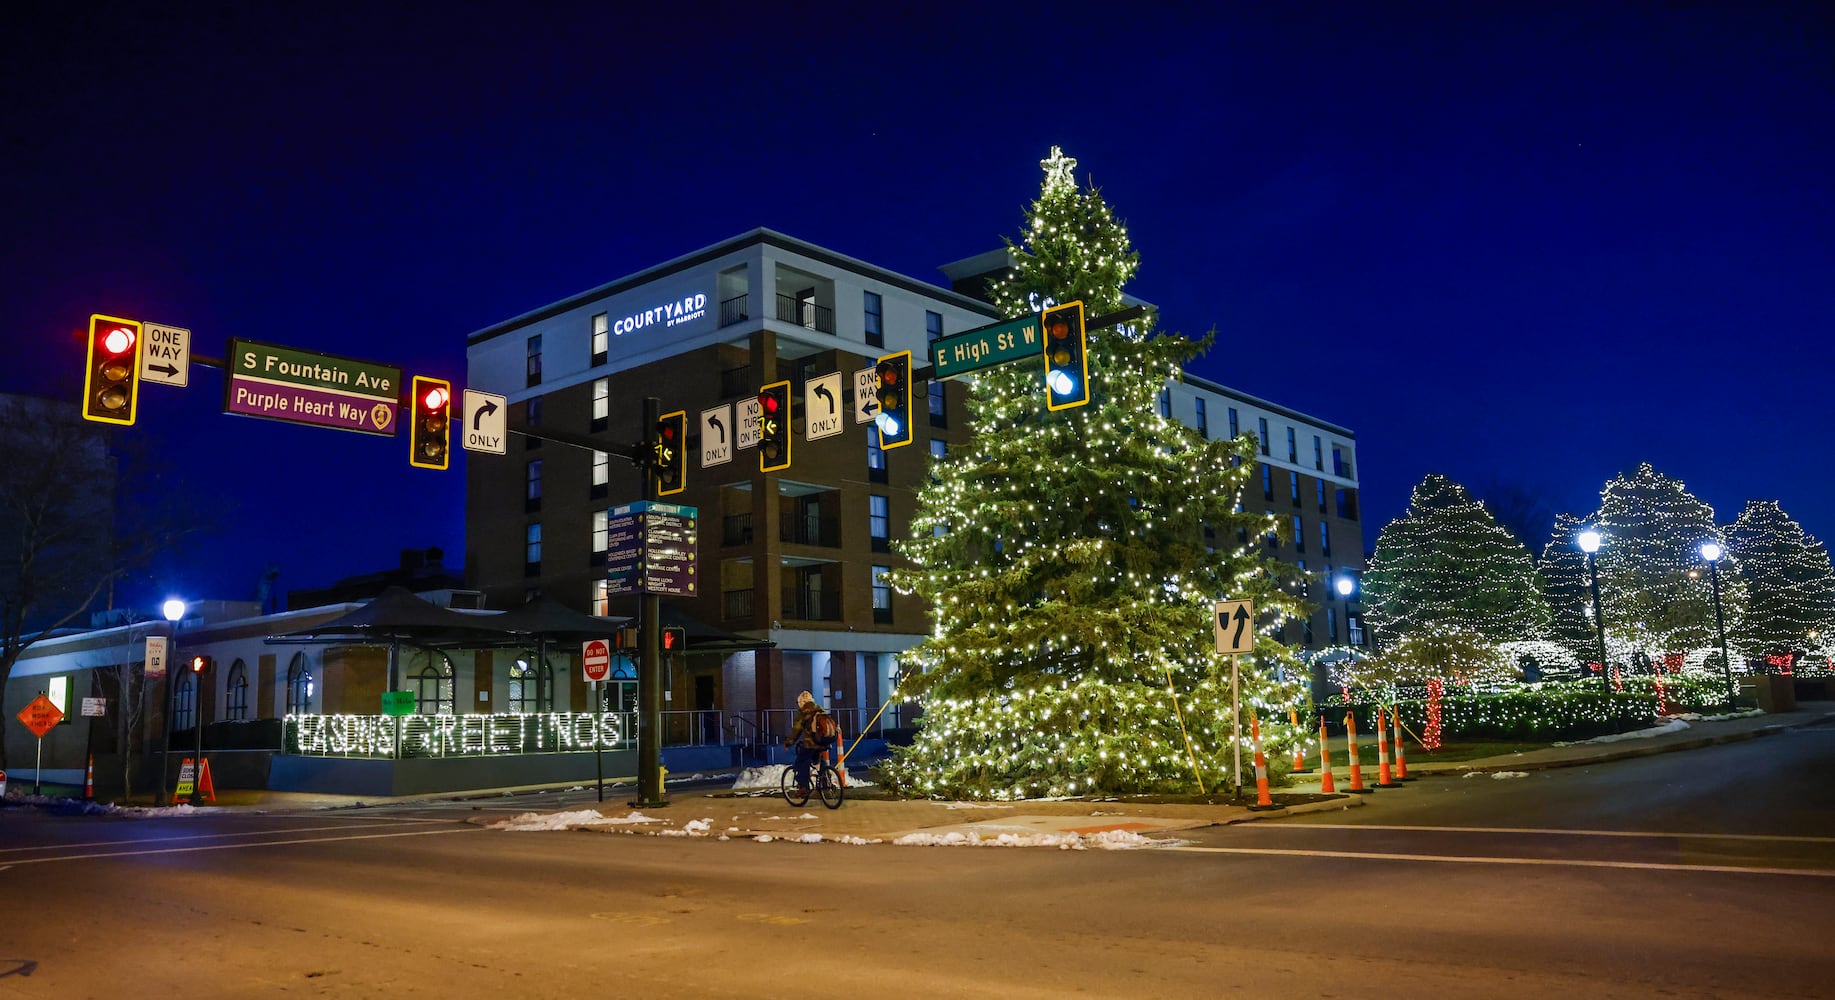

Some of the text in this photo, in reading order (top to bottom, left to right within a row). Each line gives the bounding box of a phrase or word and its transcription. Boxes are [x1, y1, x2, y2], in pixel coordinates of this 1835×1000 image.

[614, 294, 706, 335] COURTYARD
[675, 310, 705, 325] MARRIOTT
[152, 329, 181, 346] ONE
[149, 344, 182, 360] WAY
[937, 325, 1035, 367] E High St W
[243, 352, 391, 391] S Fountain Ave
[236, 387, 368, 425] Purple Heart Way
[747, 402, 759, 416] NO
[743, 416, 760, 429] TUR
[811, 417, 837, 434] ONLY
[469, 433, 500, 448] ONLY
[740, 428, 761, 443] ON RE
[705, 446, 728, 461] ONLY
[587, 647, 605, 657] DO NOT
[589, 665, 604, 673] ENTER
